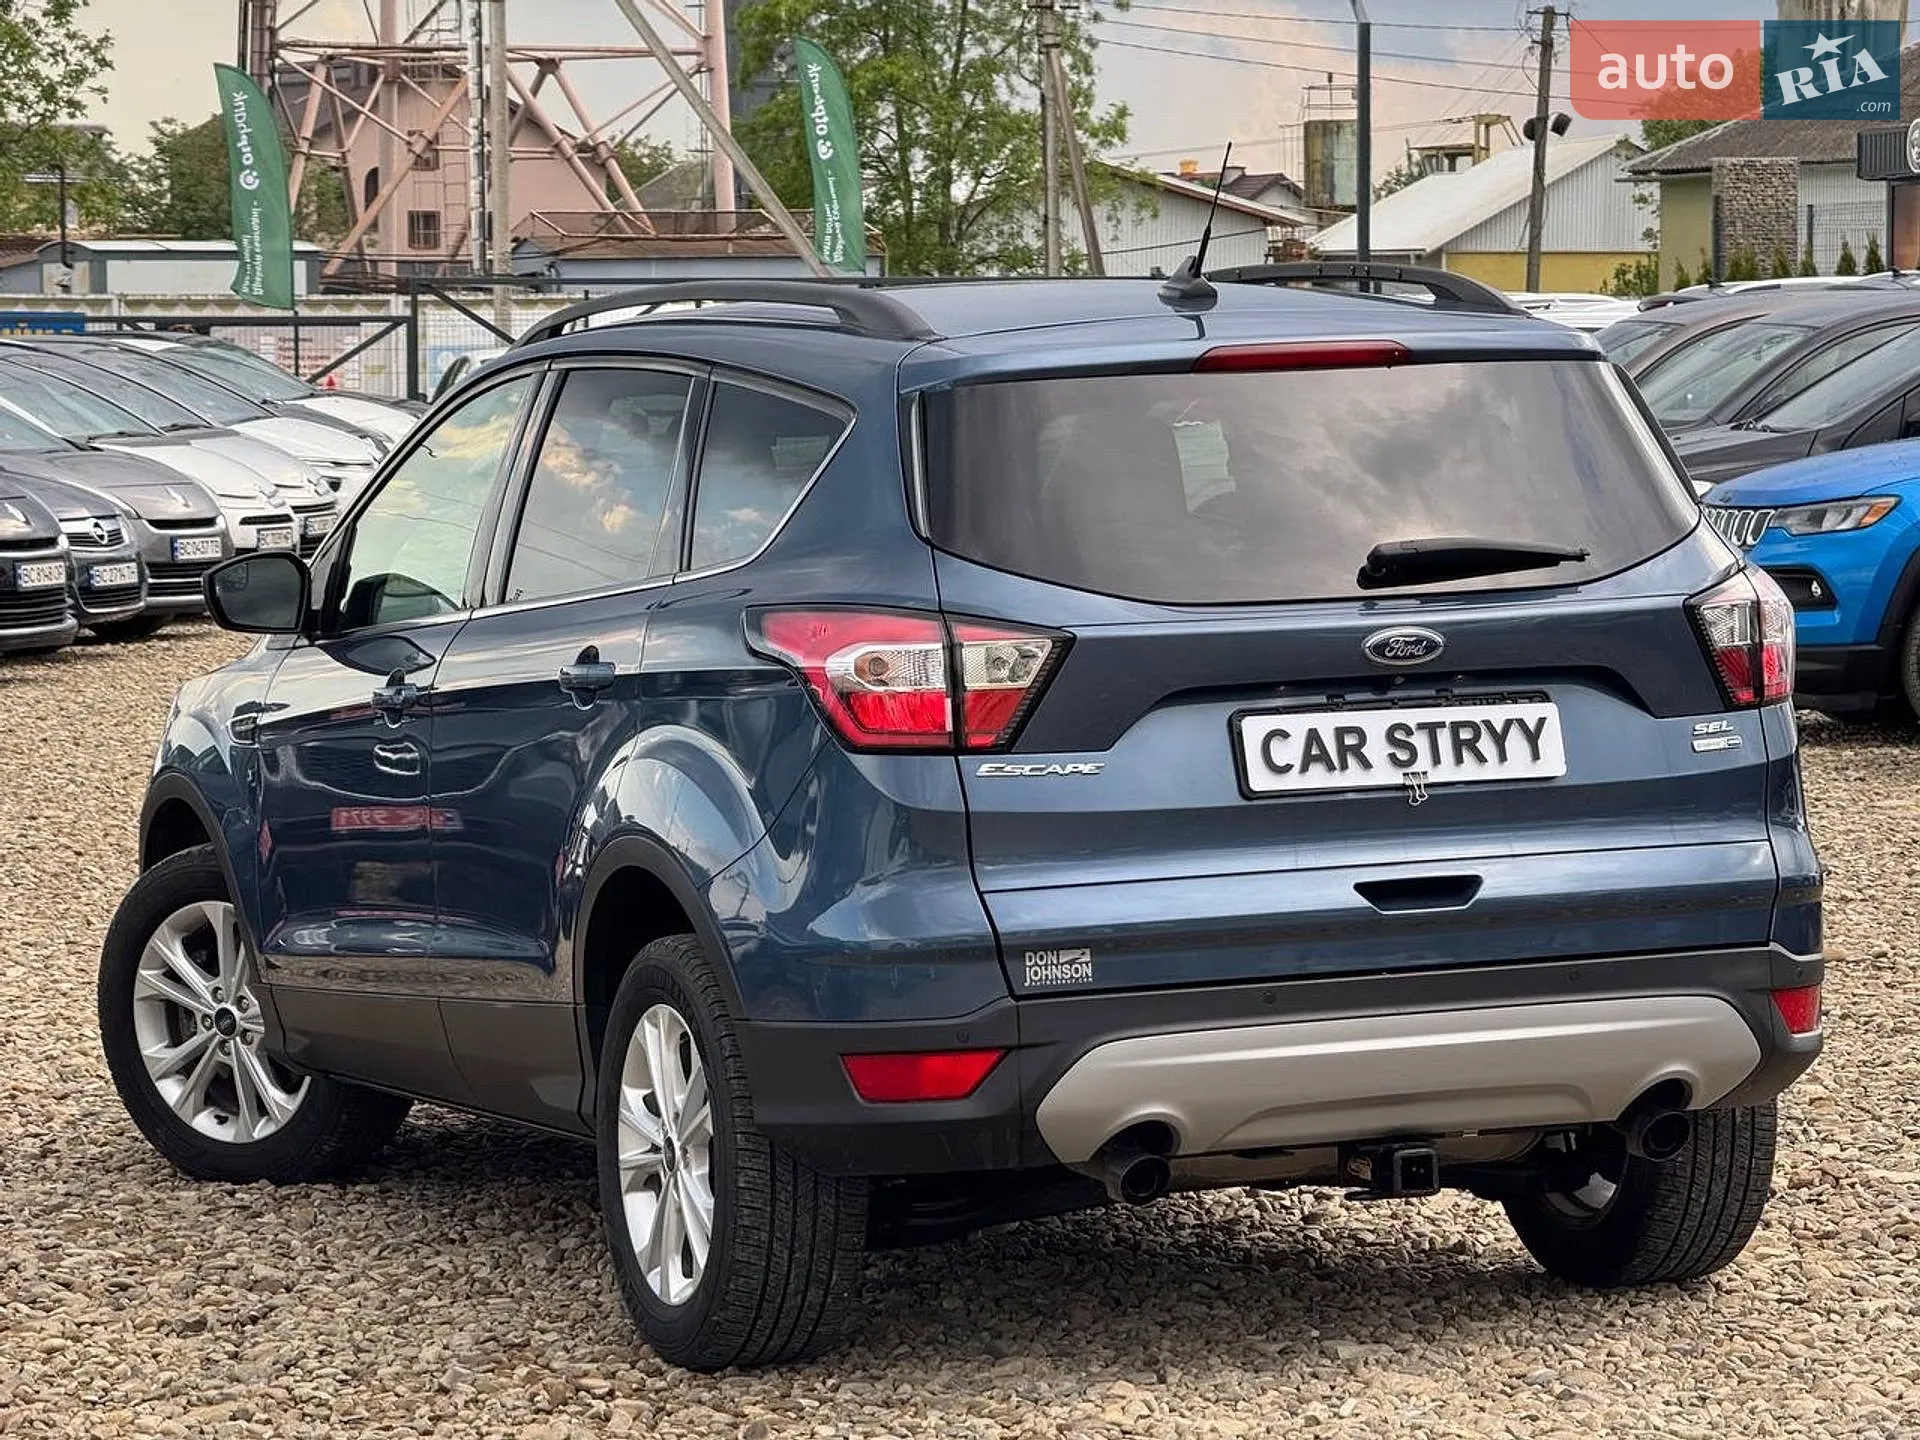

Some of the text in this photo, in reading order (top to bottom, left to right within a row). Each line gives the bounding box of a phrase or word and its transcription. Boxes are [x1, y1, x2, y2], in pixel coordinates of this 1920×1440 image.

[1384, 636, 1427, 658] Ford
[1693, 720, 1734, 735] SEL
[1261, 716, 1547, 774] CAR STRYY
[976, 763, 1105, 777] ESCAPE
[1024, 950, 1058, 966] DON
[1024, 963, 1092, 987] JOHNSON
